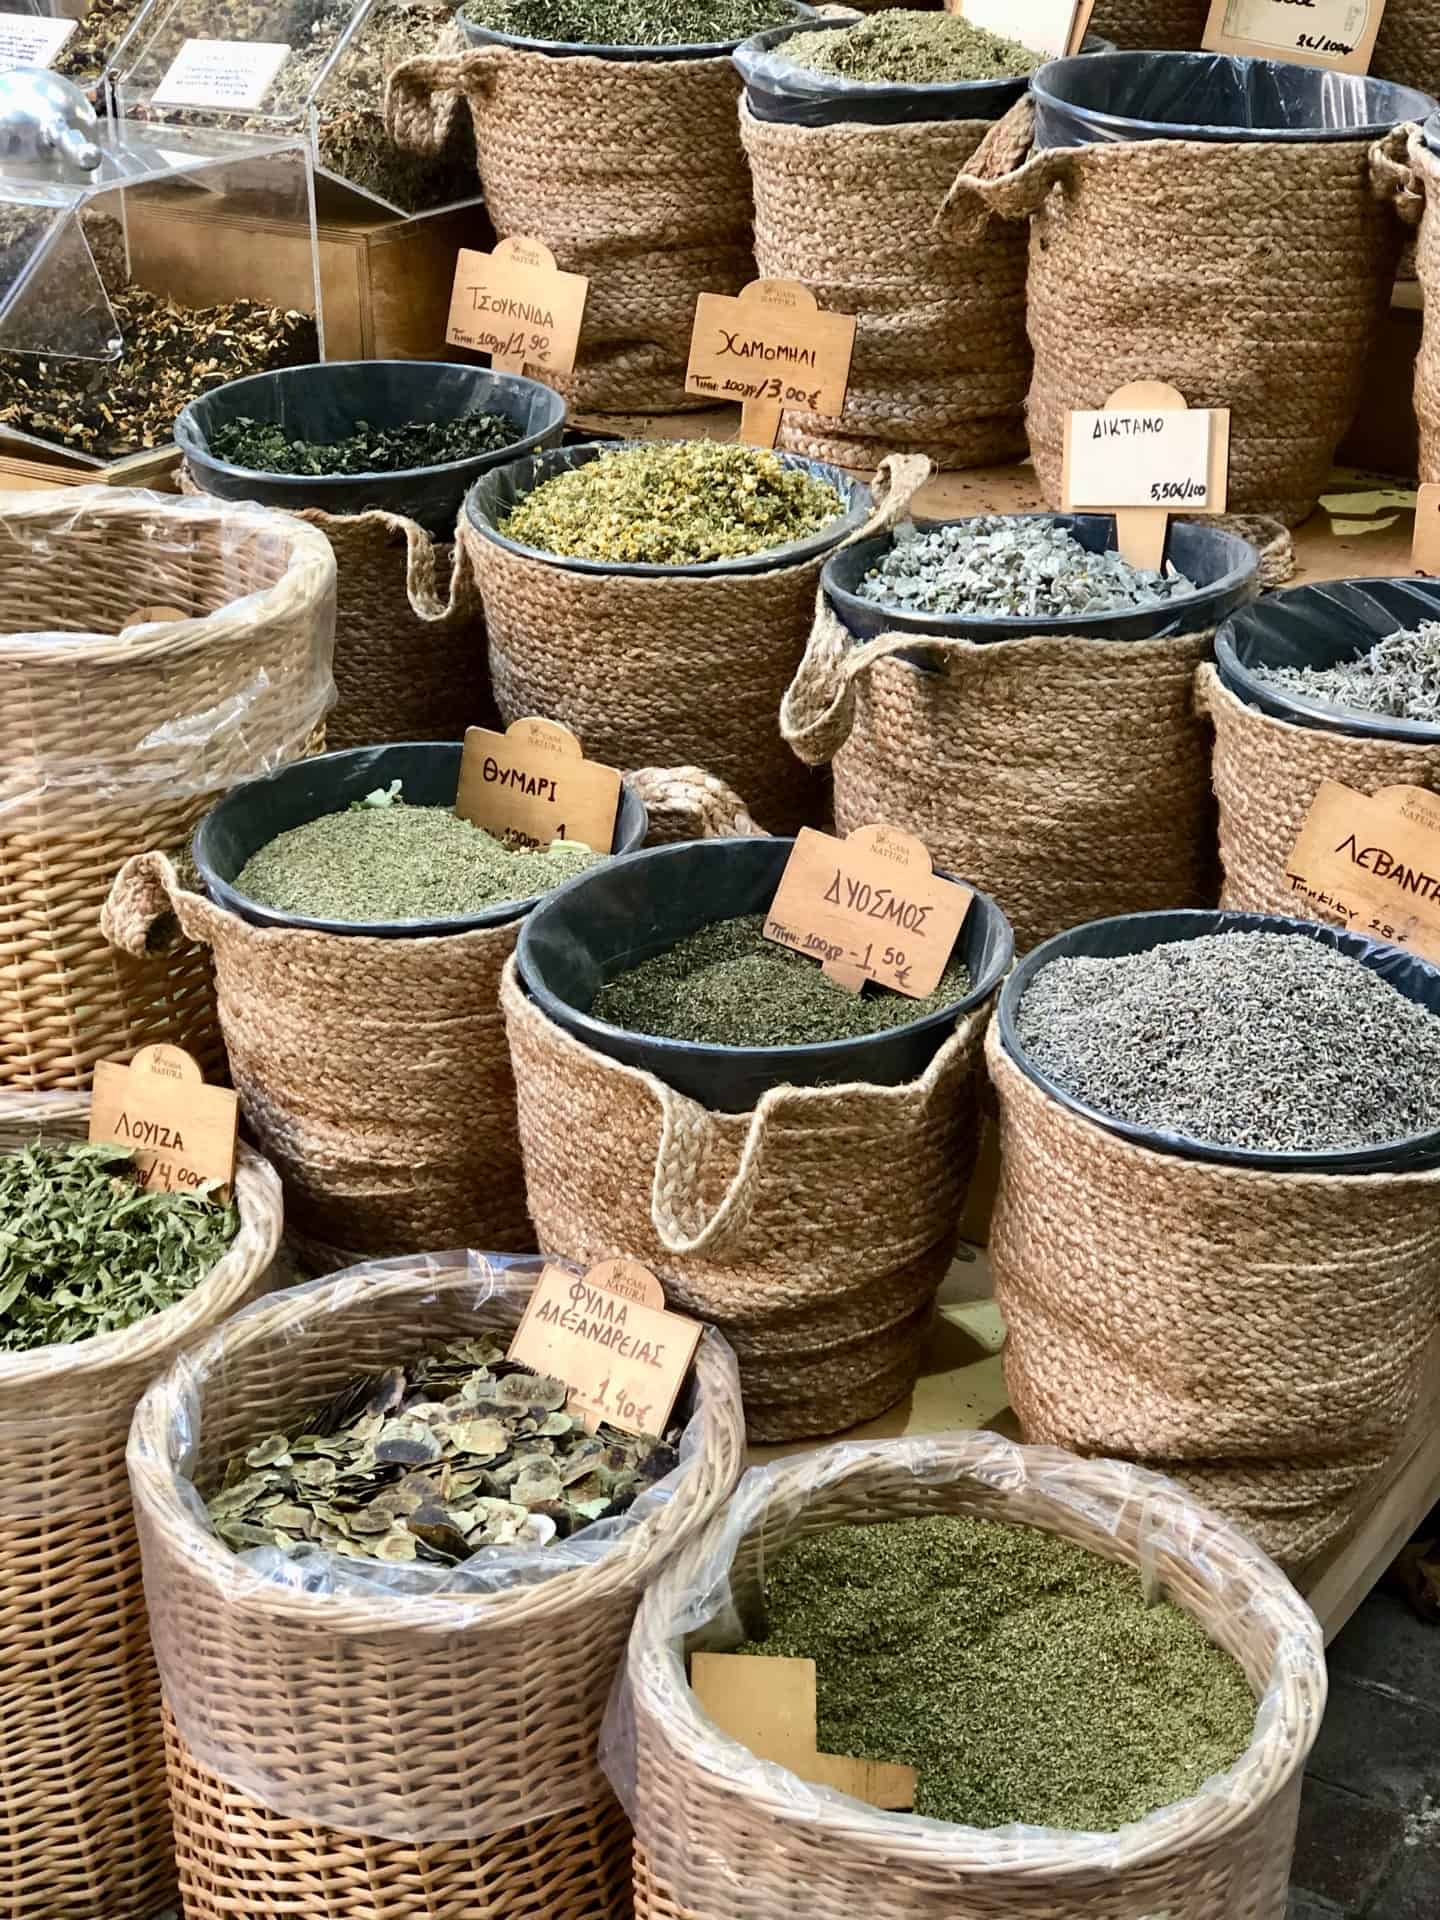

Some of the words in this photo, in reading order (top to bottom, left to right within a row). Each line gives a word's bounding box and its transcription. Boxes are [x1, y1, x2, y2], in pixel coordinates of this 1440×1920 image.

[465, 286, 555, 329] ΤΣΟΥΚΝΙΔΑ
[715, 329, 817, 369] ΧΑΜΟΜΗΛΙ
[1092, 417, 1165, 440] ΔΙΚΤΑΜΟ
[482, 757, 559, 802] ΘΥΜΑΡΙ
[823, 867, 934, 937] ΔΥΟΣΜΟΣ
[114, 1111, 185, 1152] ΛΟΥΙΖΑ
[568, 1277, 628, 1327] ΦΥΛΛΑ
[535, 1298, 666, 1369] ΑΛΕΞΑΝΔΡΕΙΑΣ
